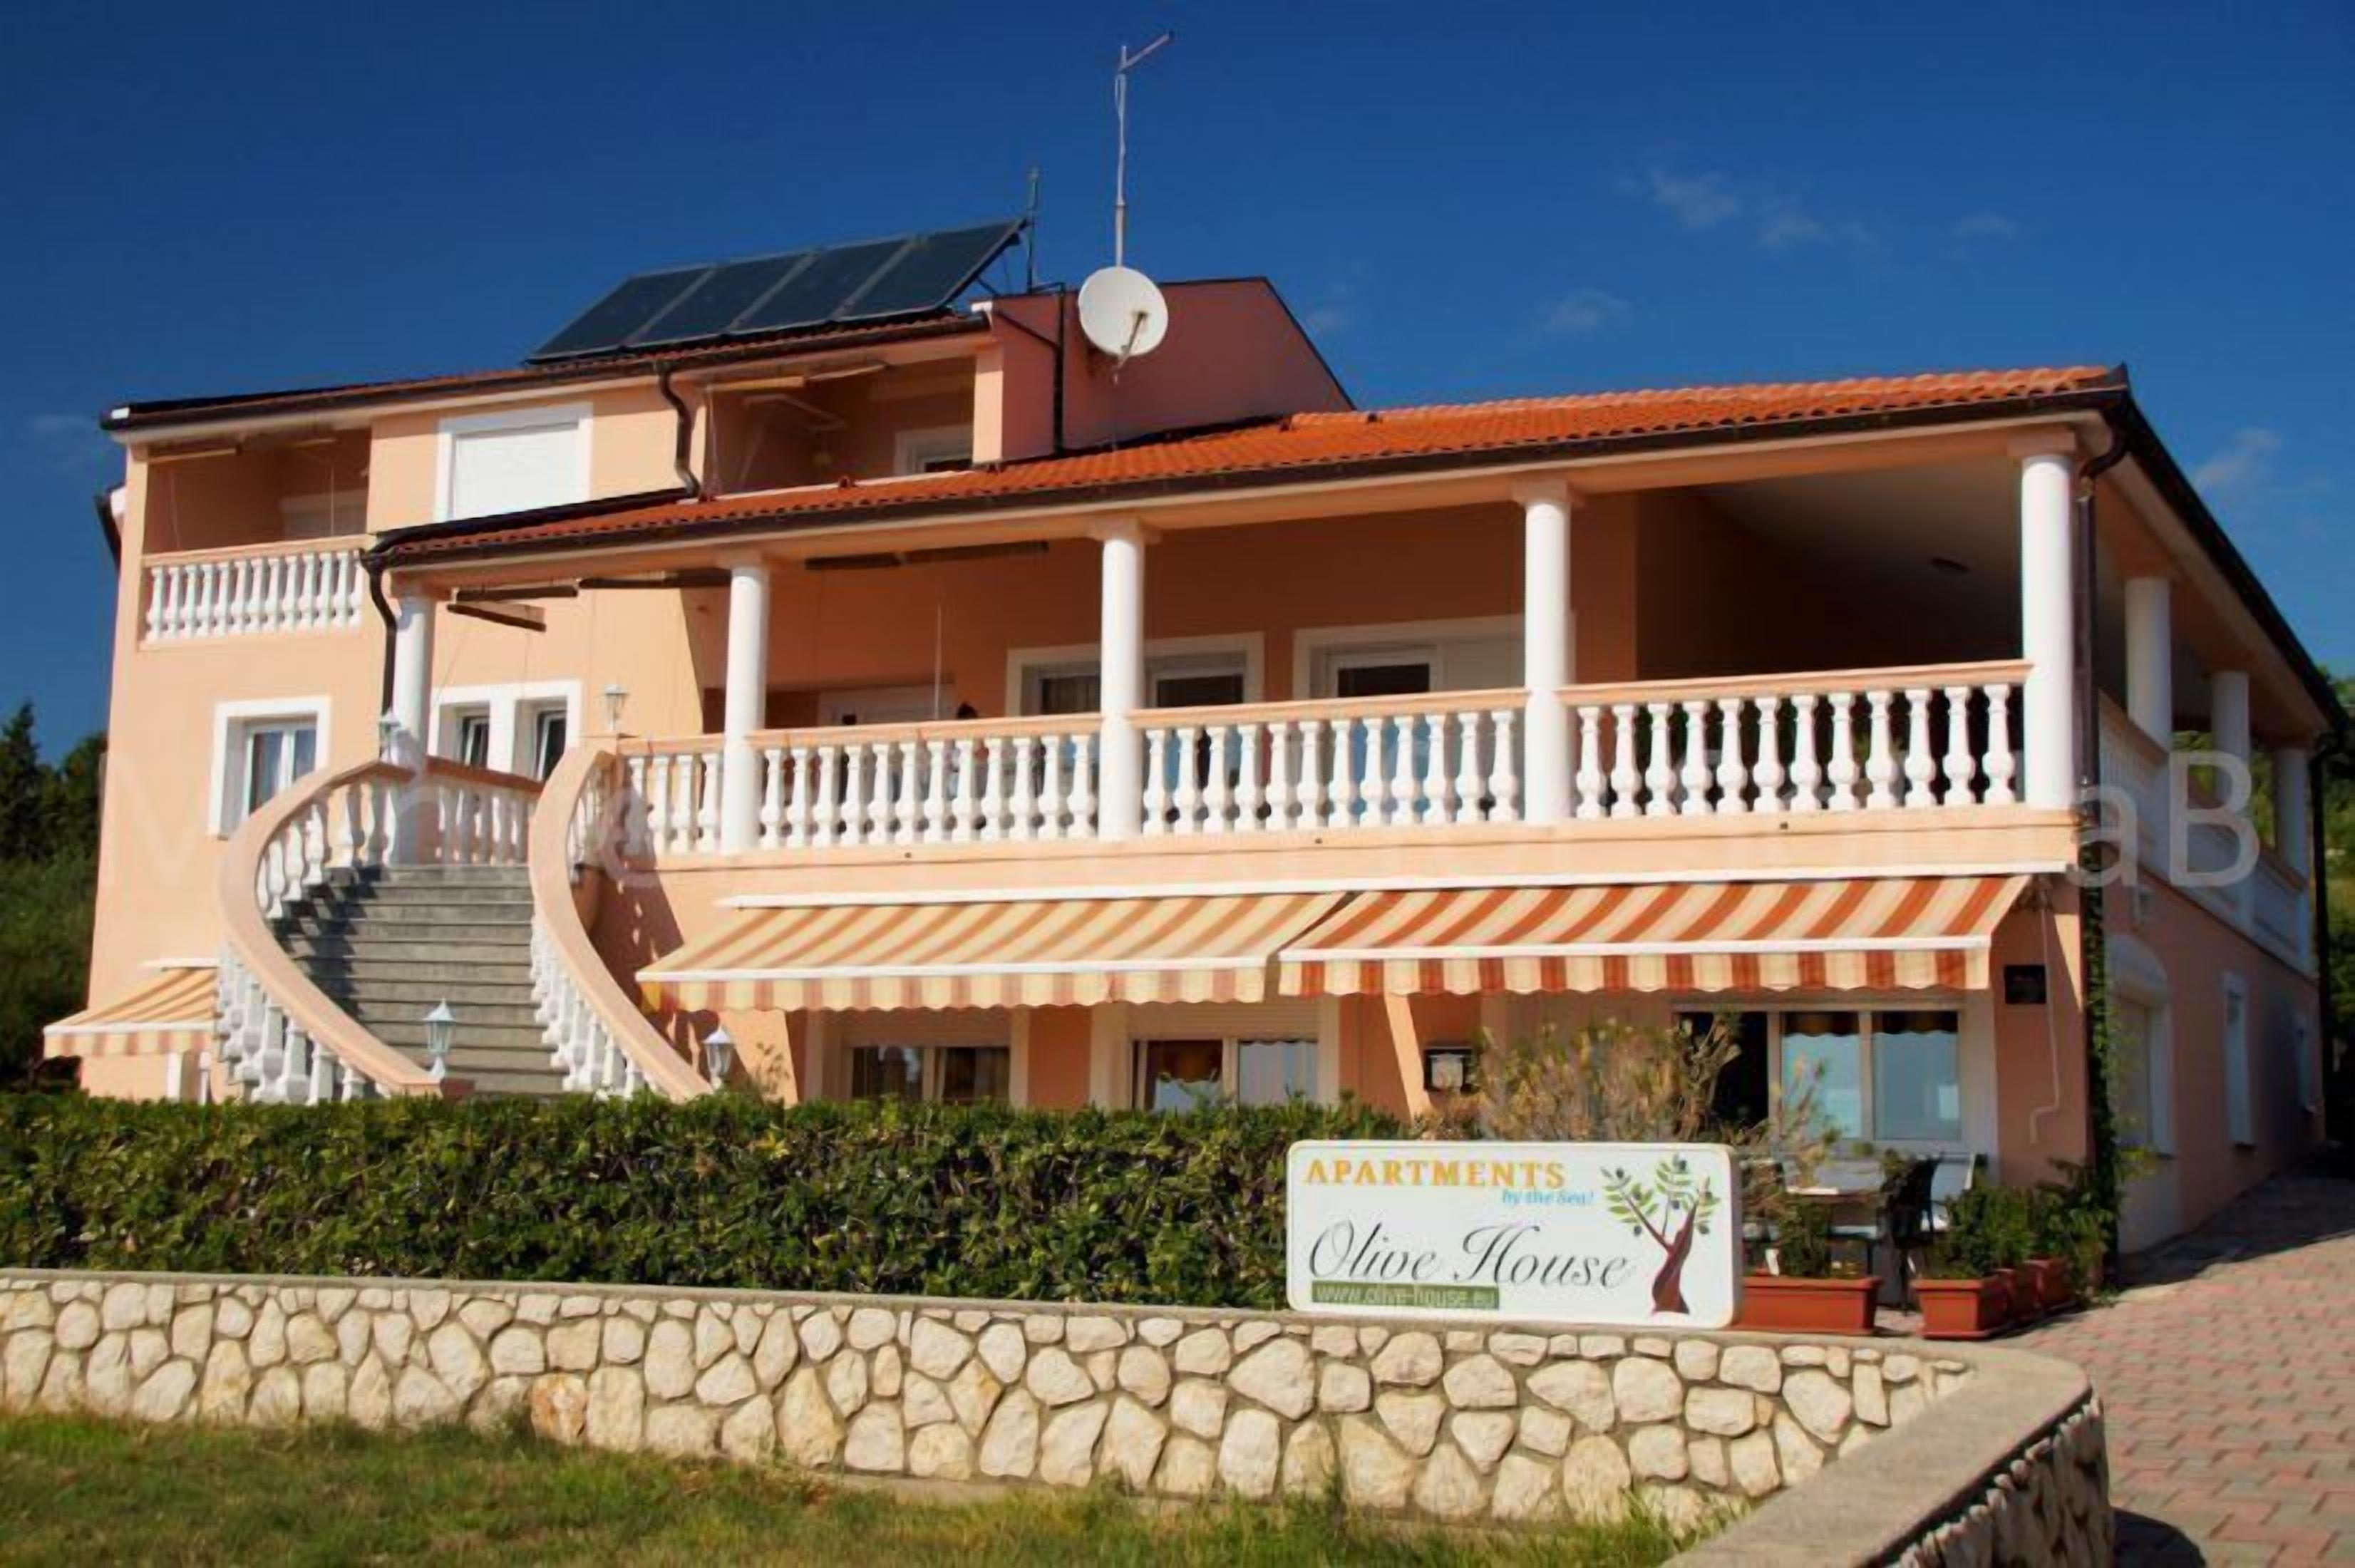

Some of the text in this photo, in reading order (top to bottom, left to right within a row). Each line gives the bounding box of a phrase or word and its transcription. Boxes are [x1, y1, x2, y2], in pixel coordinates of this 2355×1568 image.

[1307, 1159, 1565, 1188] APARTMENTS
[1502, 1189, 1521, 1207] by
[1524, 1189, 1552, 1205] the
[1309, 1219, 1635, 1289] Olive House
